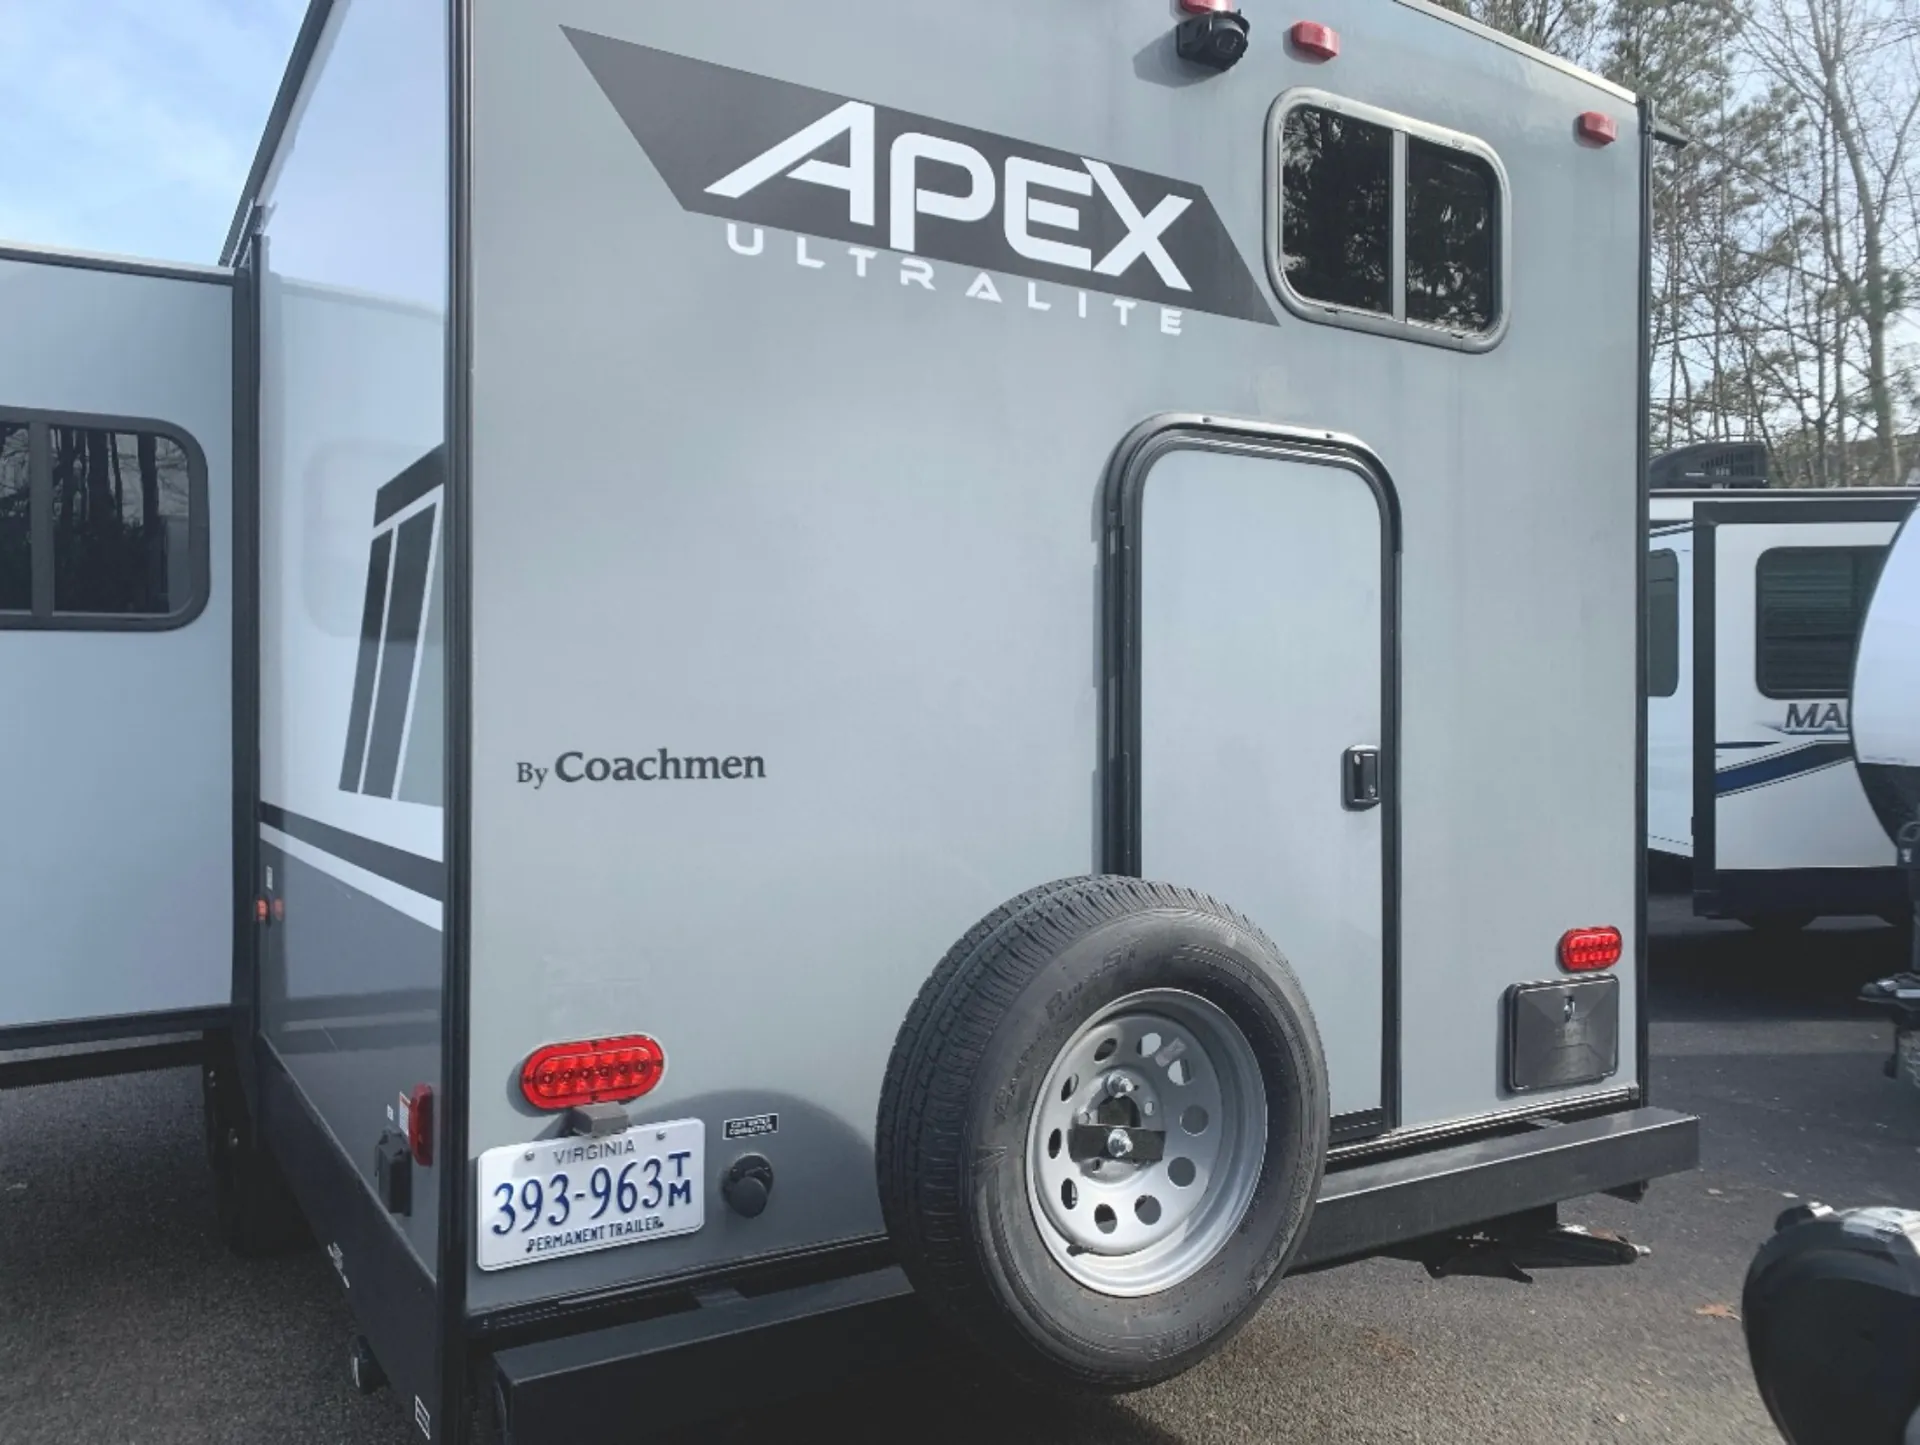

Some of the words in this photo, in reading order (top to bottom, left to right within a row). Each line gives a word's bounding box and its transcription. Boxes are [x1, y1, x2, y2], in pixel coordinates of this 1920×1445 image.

[703, 100, 1193, 291] APEX
[726, 222, 1183, 335] ULTRALITE
[1785, 703, 1849, 728] MA
[516, 761, 549, 790] By
[555, 747, 766, 783] Coachmen
[553, 1139, 637, 1166] VIRGINIA
[528, 1223, 606, 1251] PERMANENT
[608, 1215, 661, 1240] TRAILER
